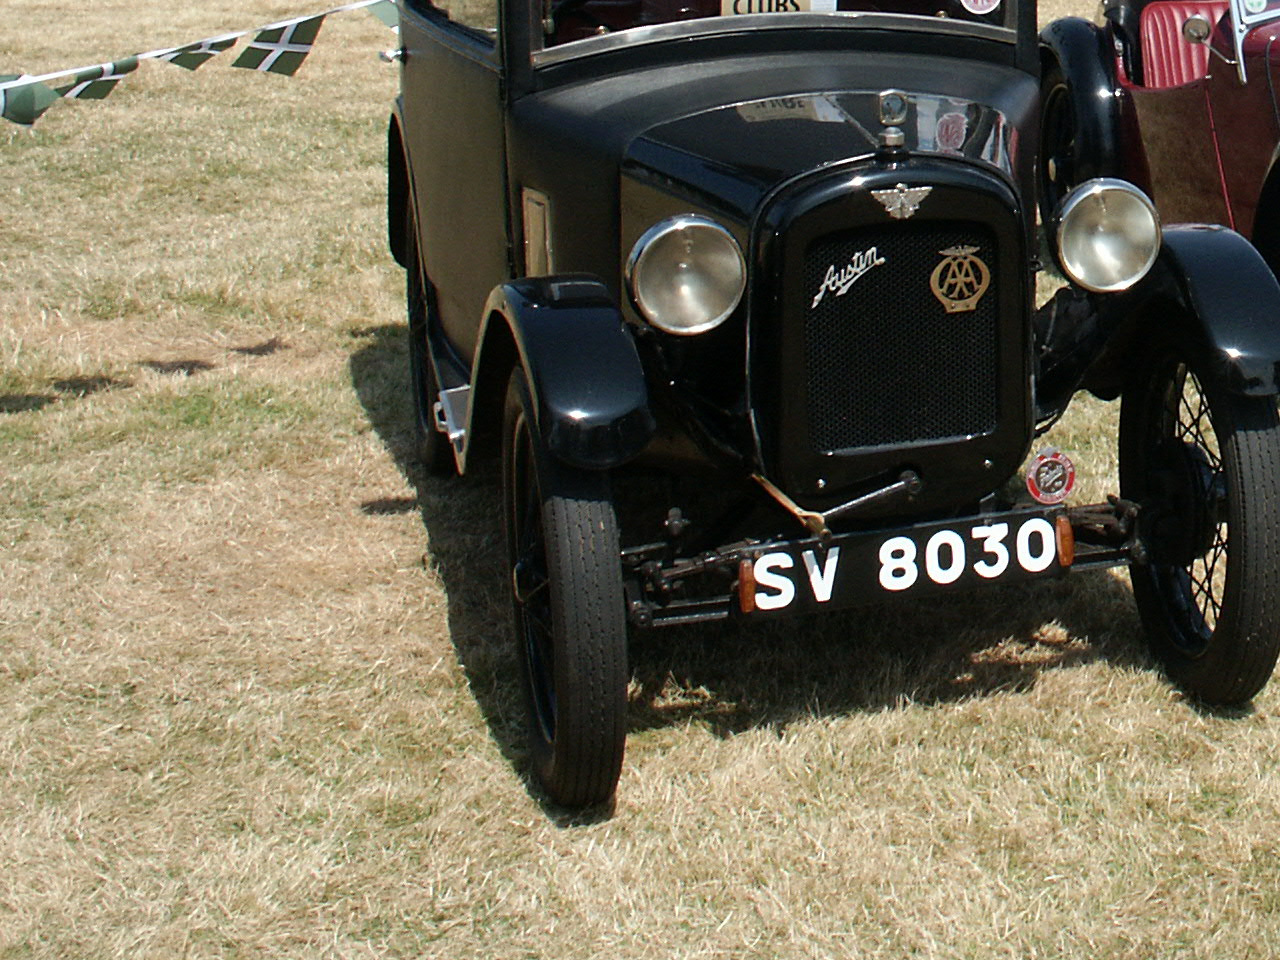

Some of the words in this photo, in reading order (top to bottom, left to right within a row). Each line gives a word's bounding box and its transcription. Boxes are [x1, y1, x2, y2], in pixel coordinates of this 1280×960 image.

[811, 246, 886, 309] Austin
[752, 545, 841, 611] SV
[878, 517, 1057, 591] 8030
